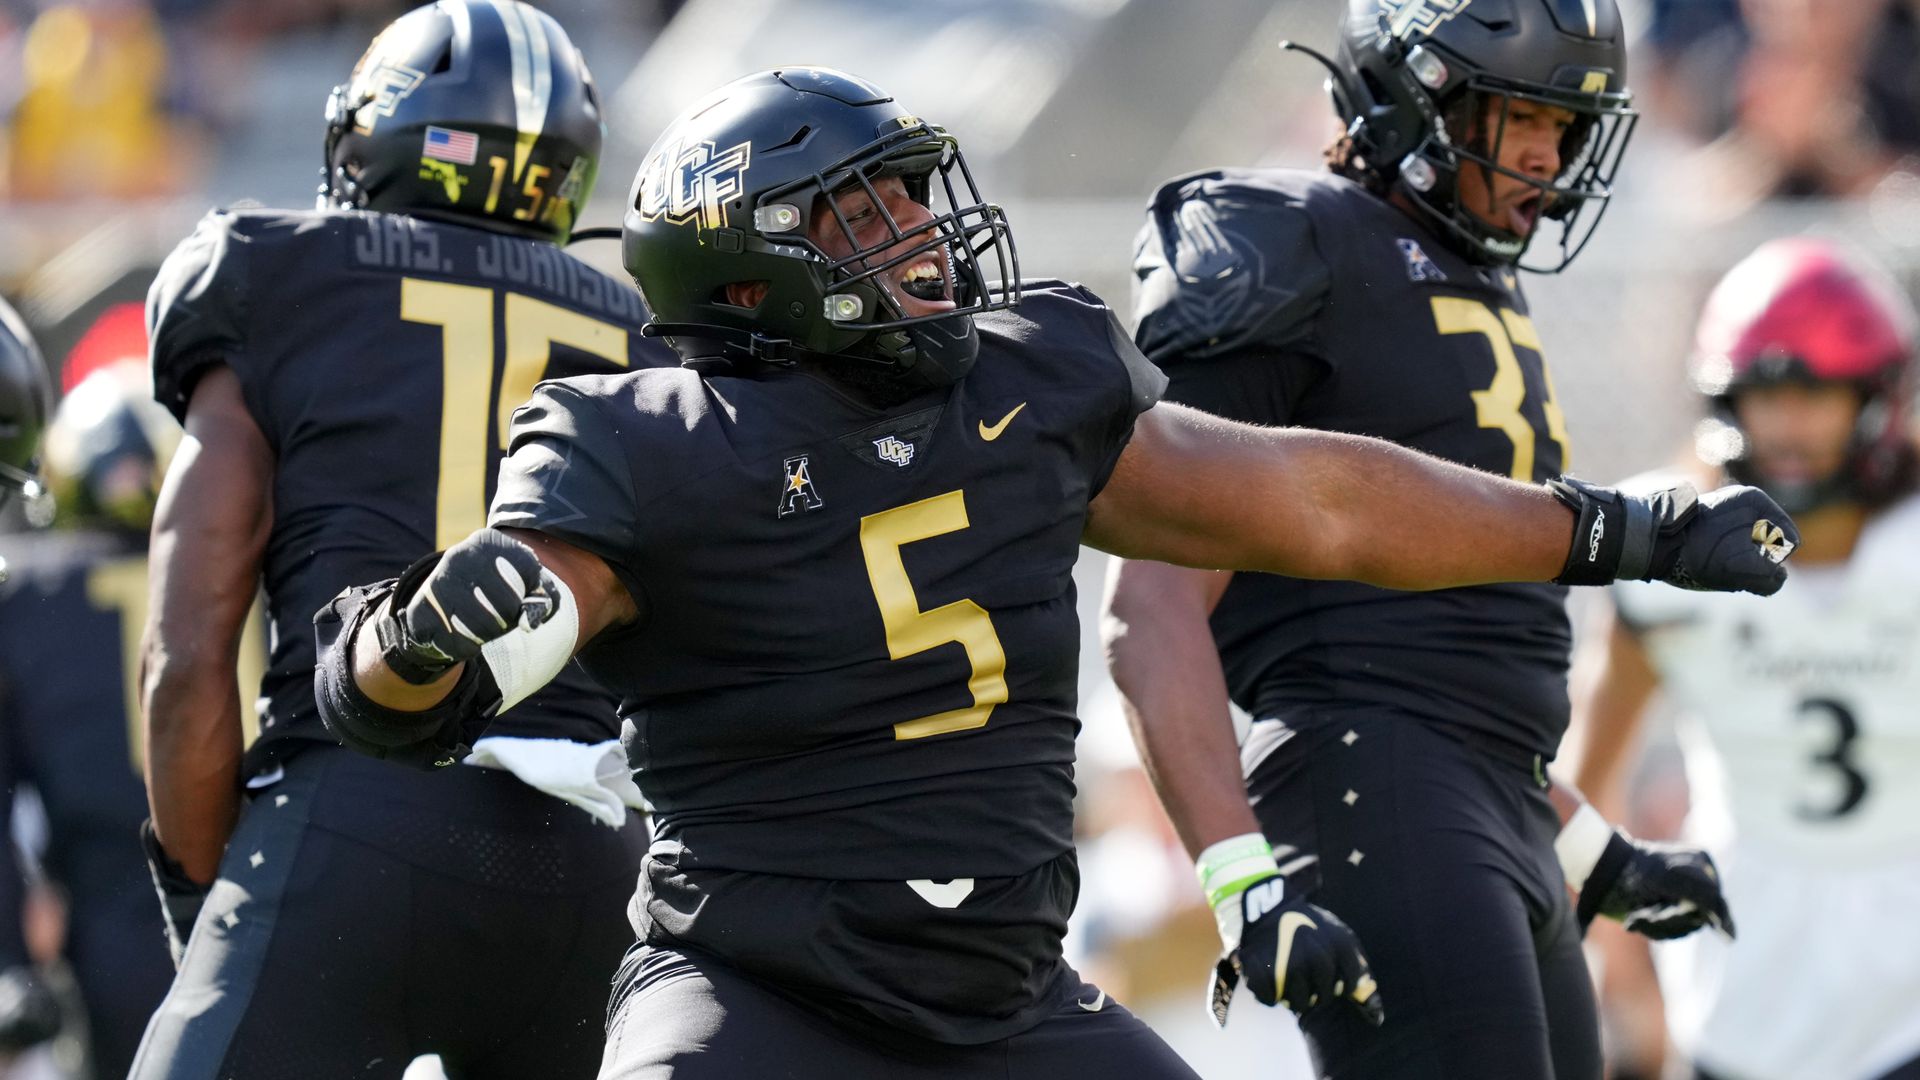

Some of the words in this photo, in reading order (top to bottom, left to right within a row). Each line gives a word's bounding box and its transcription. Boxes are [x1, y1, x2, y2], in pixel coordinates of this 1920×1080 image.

[484, 155, 551, 221] 15
[640, 136, 751, 229] UCF
[355, 214, 453, 273] JAS.
[873, 436, 914, 467] UCF
[777, 453, 823, 519] A
[859, 488, 1009, 741] 5
[1795, 697, 1869, 823] 3
